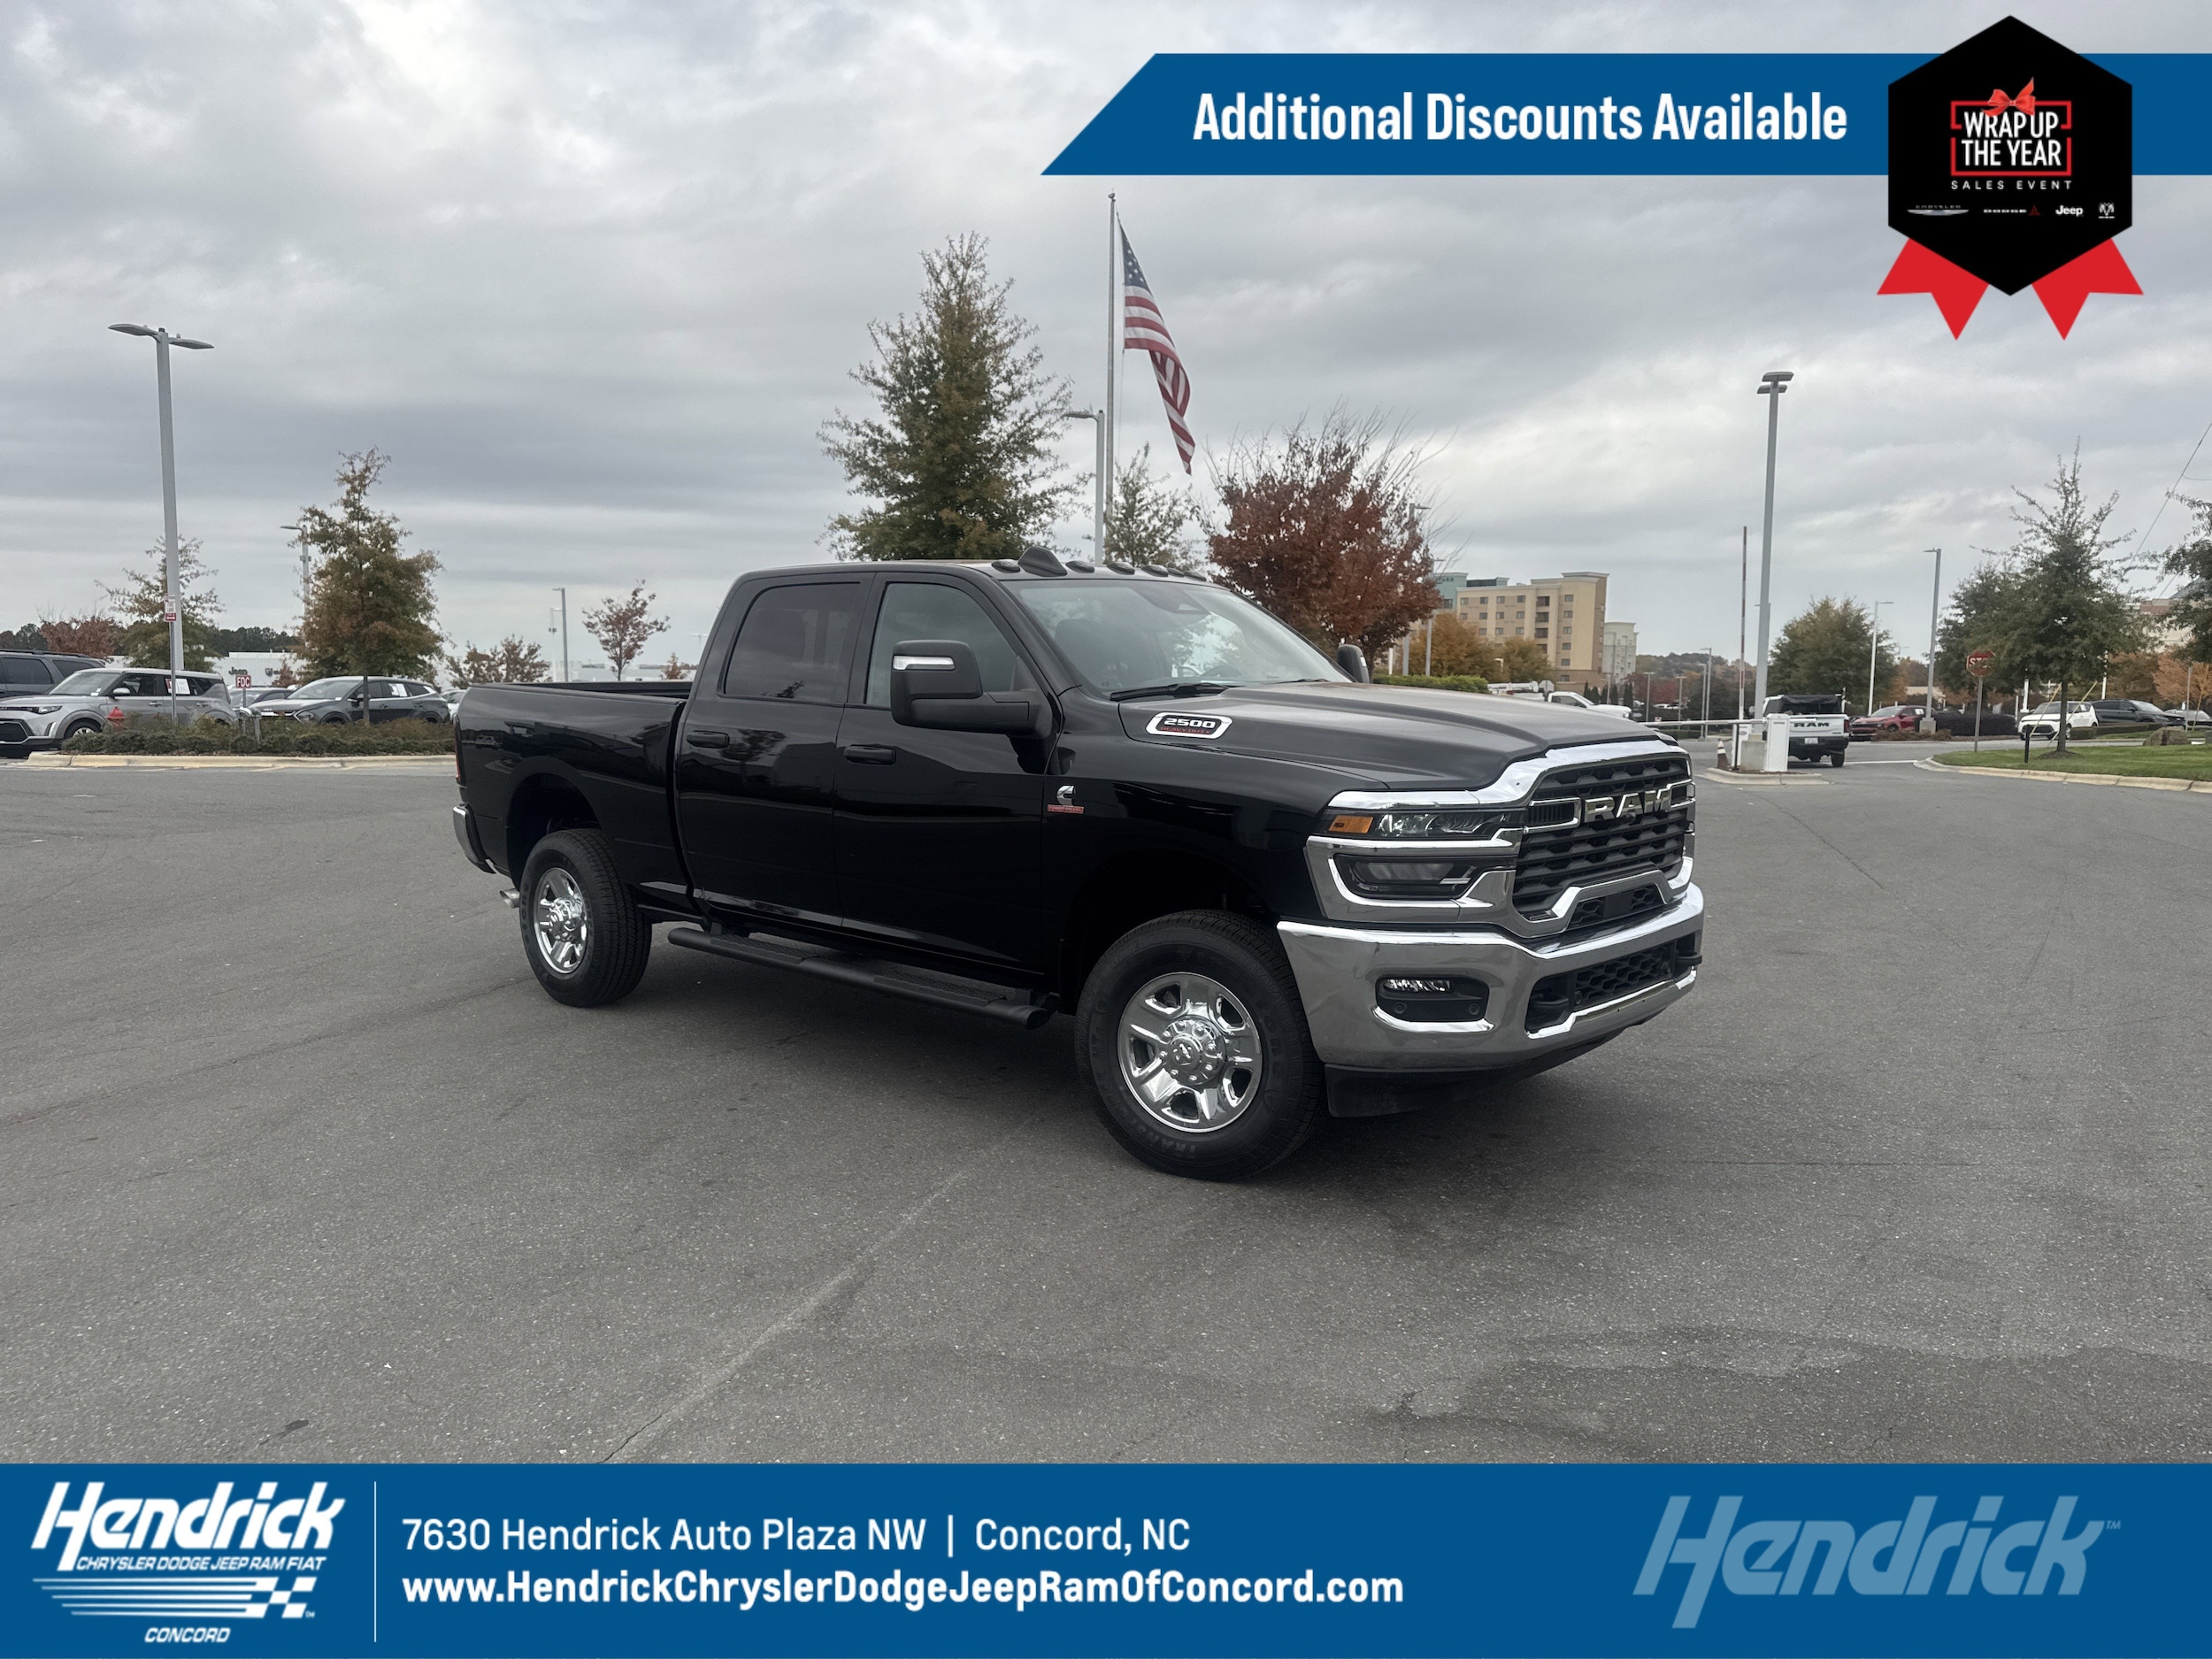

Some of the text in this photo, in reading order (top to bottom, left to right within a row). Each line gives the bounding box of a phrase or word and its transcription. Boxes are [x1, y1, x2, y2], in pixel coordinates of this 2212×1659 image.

[236, 676, 250, 688] FDC
[1164, 718, 1216, 728] 2500
[1584, 787, 1671, 823] RAM
